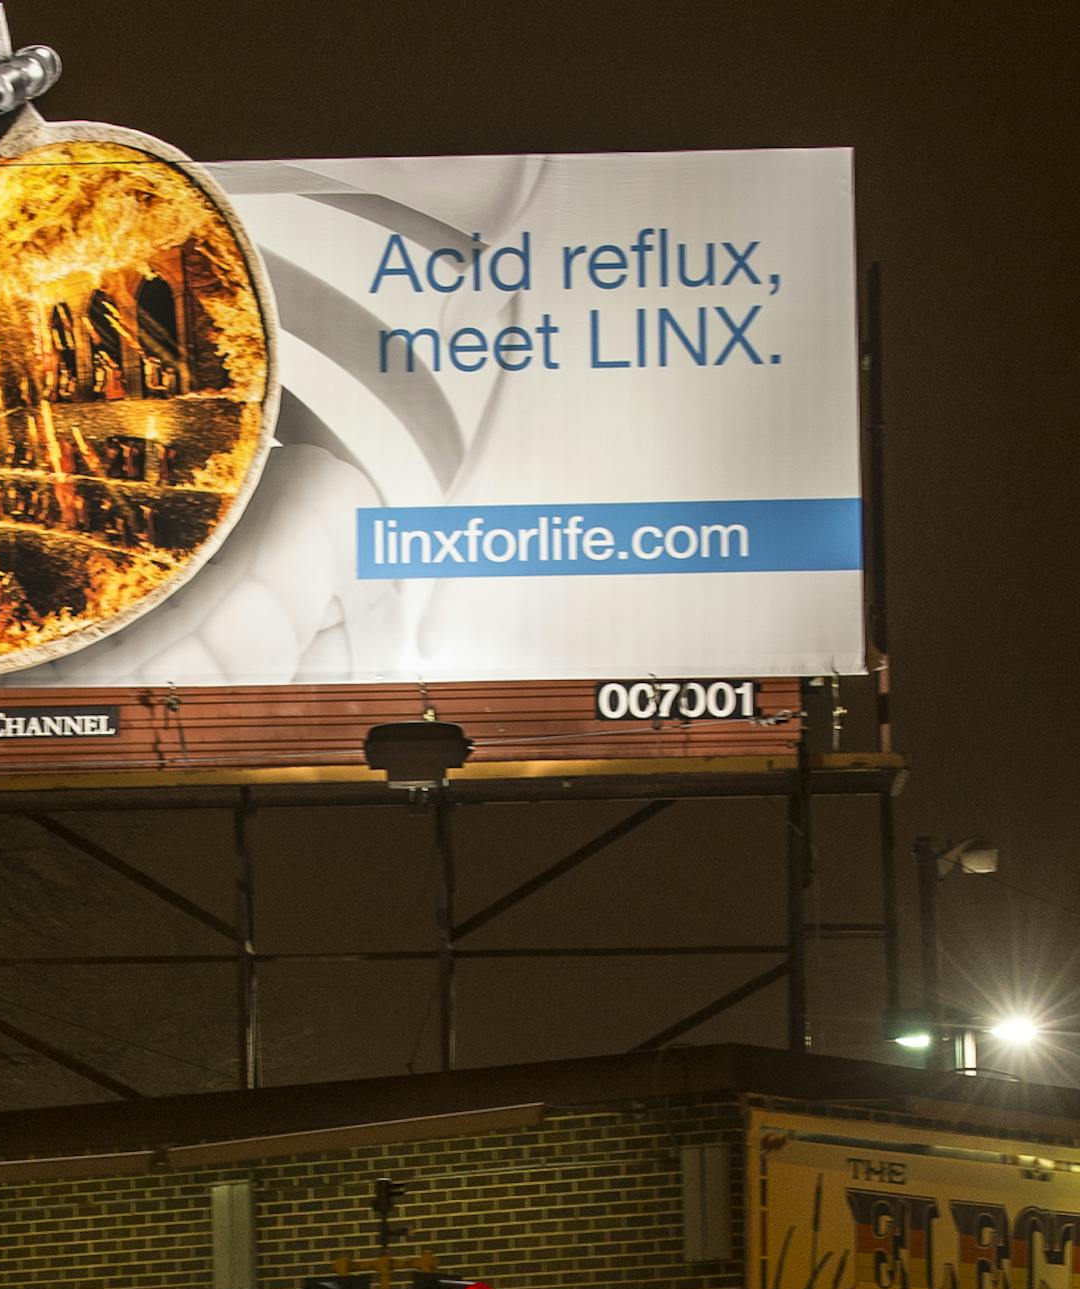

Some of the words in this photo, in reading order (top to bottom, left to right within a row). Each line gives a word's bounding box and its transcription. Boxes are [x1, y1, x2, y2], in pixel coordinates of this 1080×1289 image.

[369, 232, 532, 294] Acid
[562, 228, 783, 294] reflux,
[378, 314, 560, 373] meet
[590, 305, 783, 369] LINX.
[374, 515, 750, 564] linxforlife.com
[598, 681, 754, 719] 007001
[847, 1158, 906, 1185] THE
